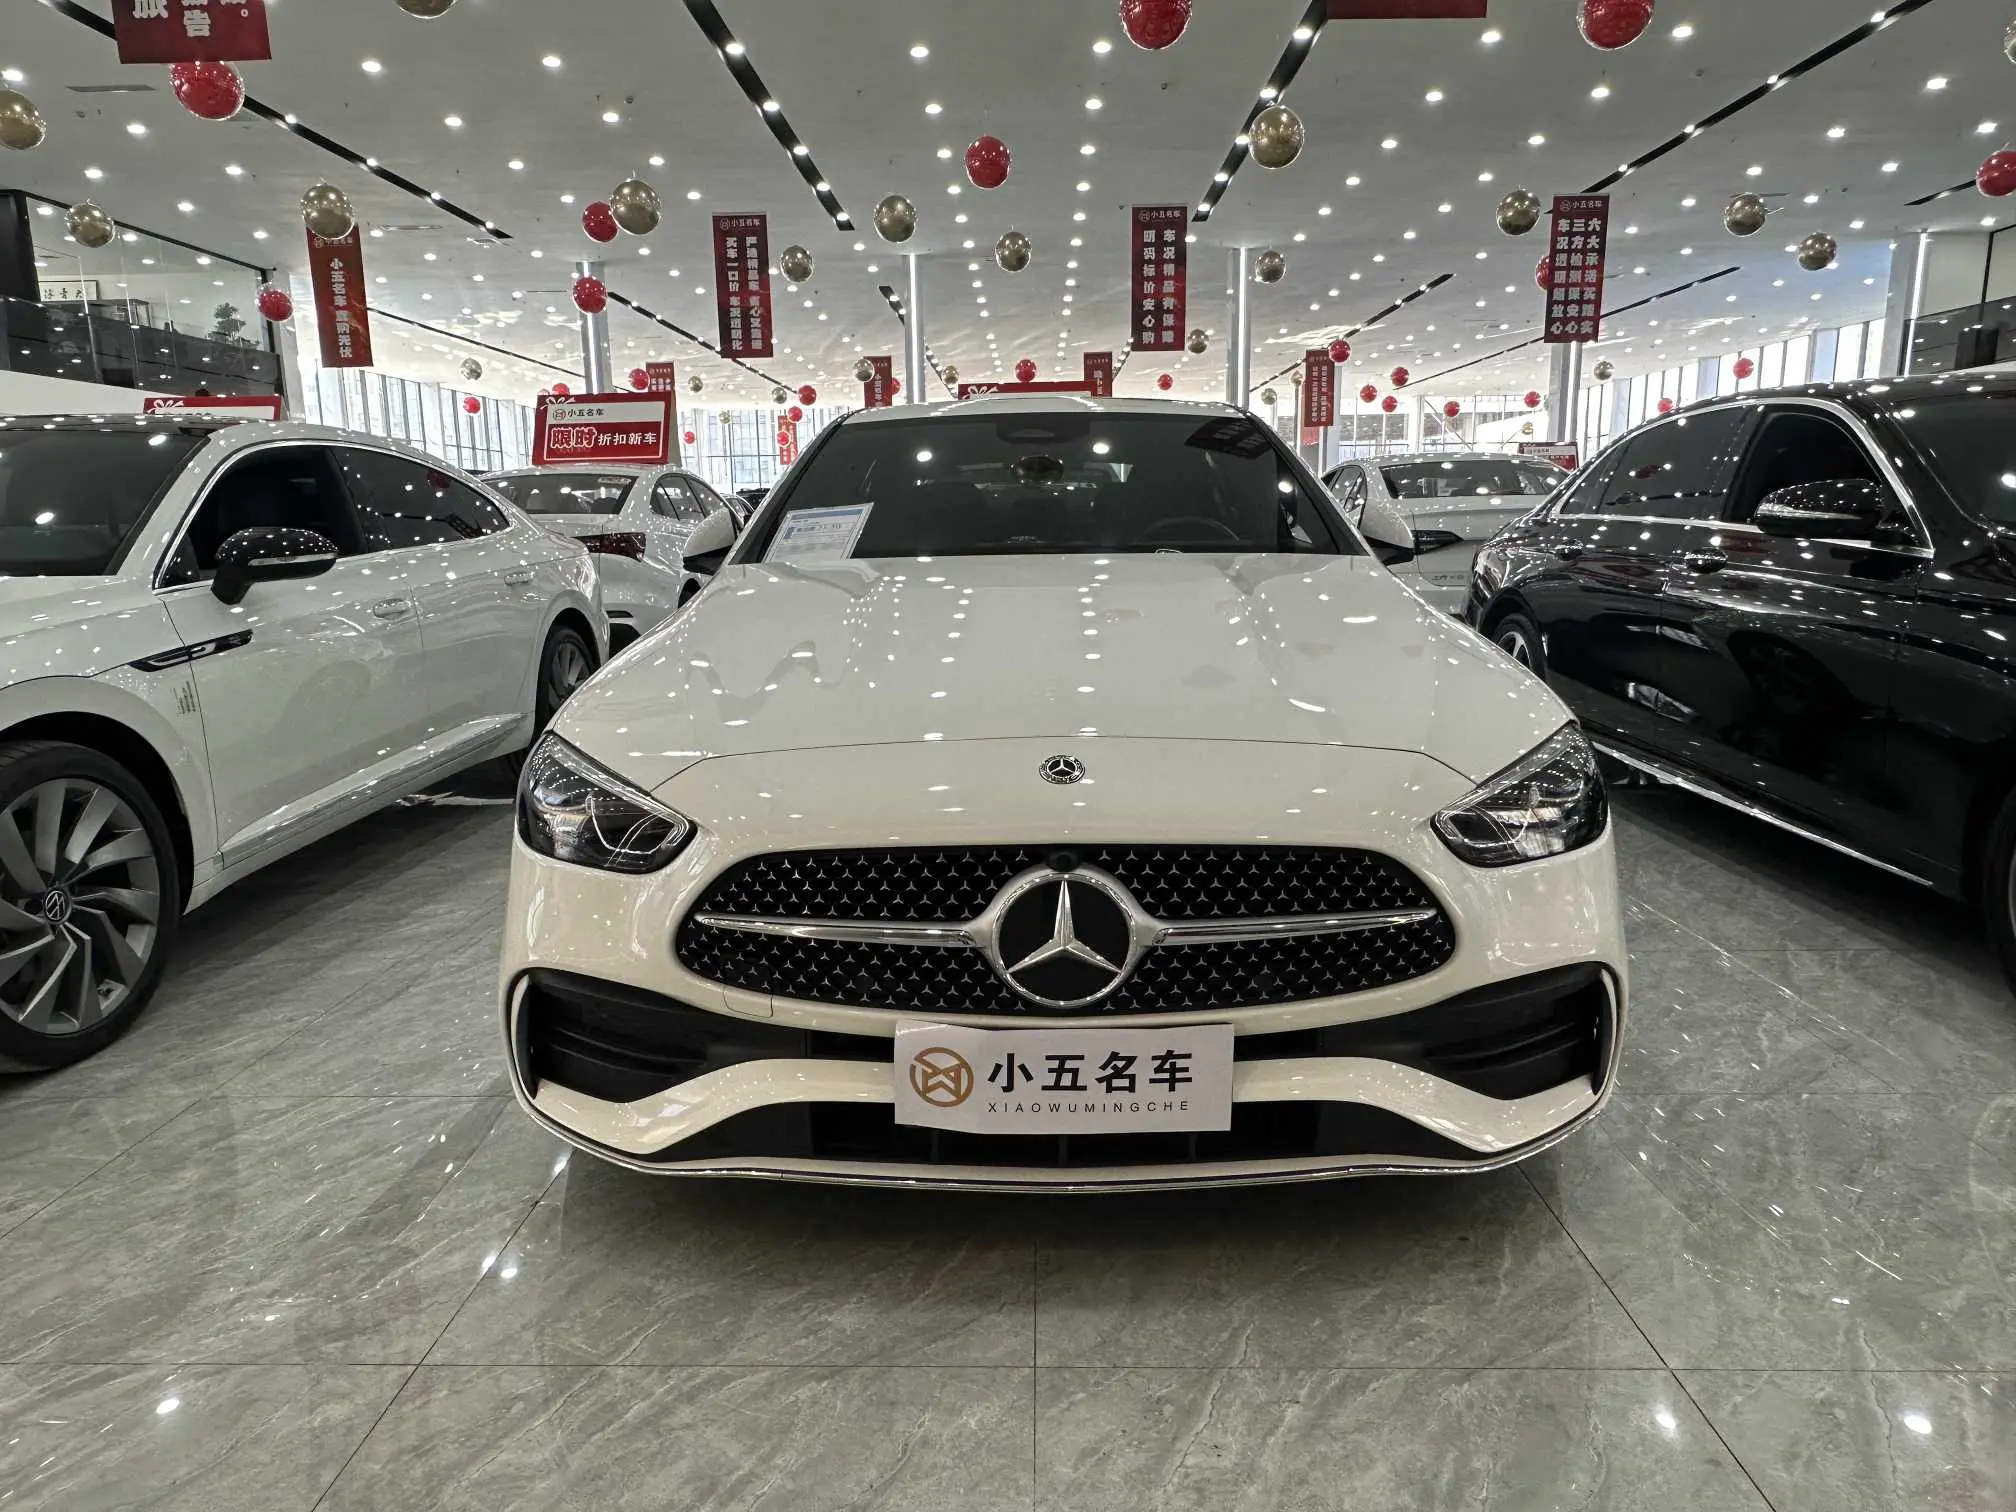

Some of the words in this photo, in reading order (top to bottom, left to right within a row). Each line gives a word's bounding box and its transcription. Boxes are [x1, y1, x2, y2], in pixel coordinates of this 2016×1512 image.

[329, 257, 347, 308] 小五名车
[568, 408, 605, 418] 小五名车
[549, 426, 598, 449] 限时
[598, 432, 657, 446] 折扣新车
[987, 1049, 1193, 1094] 小五名车
[988, 1101, 1188, 1113] XIAOWUMINGCHE
